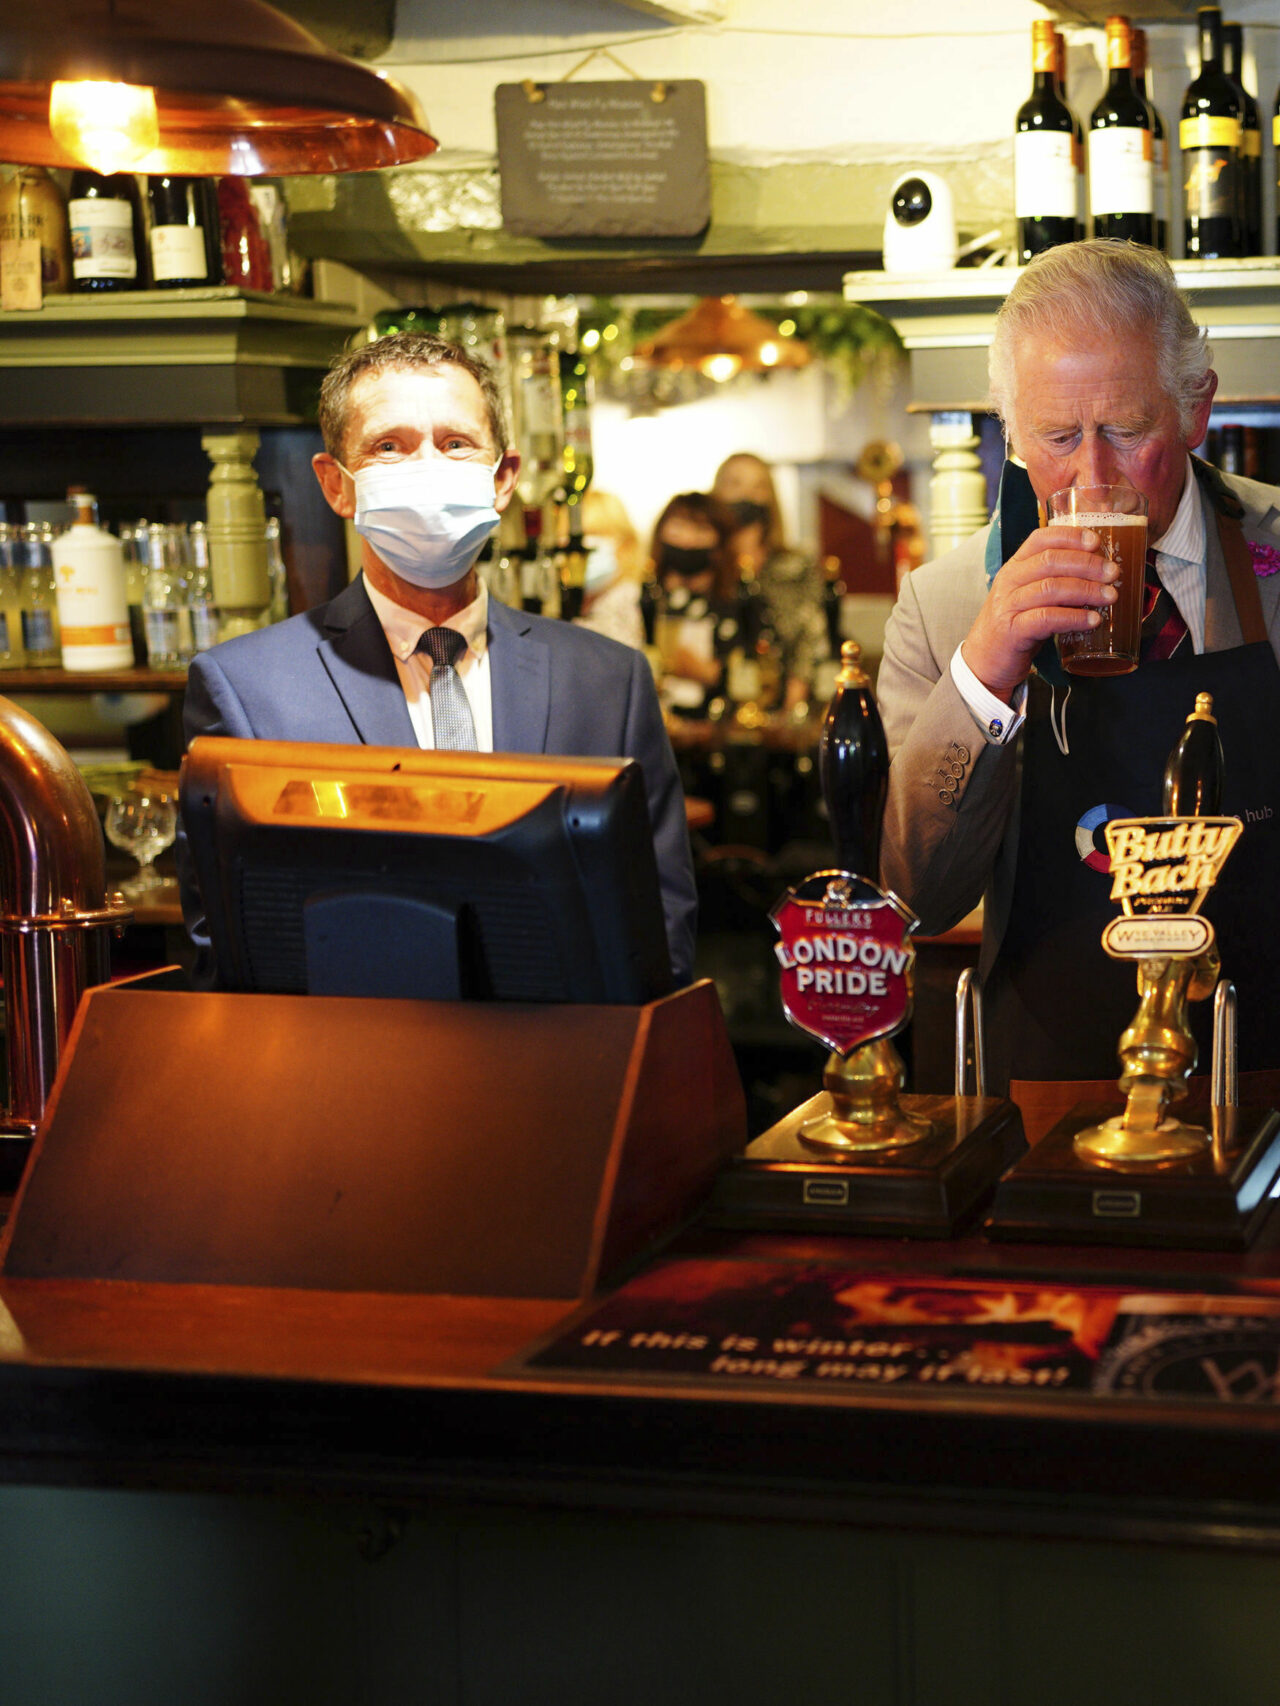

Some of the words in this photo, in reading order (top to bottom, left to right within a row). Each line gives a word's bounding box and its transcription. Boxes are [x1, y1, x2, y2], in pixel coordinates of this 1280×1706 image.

[1245, 806, 1273, 822] hub
[1109, 821, 1239, 867] Butty
[1109, 855, 1217, 900] Bach
[774, 935, 908, 977] LONDON
[796, 966, 888, 996] PRIDE
[628, 1330, 709, 1351] this
[719, 1333, 760, 1353] is
[710, 1354, 808, 1379] long
[816, 1362, 909, 1383] may
